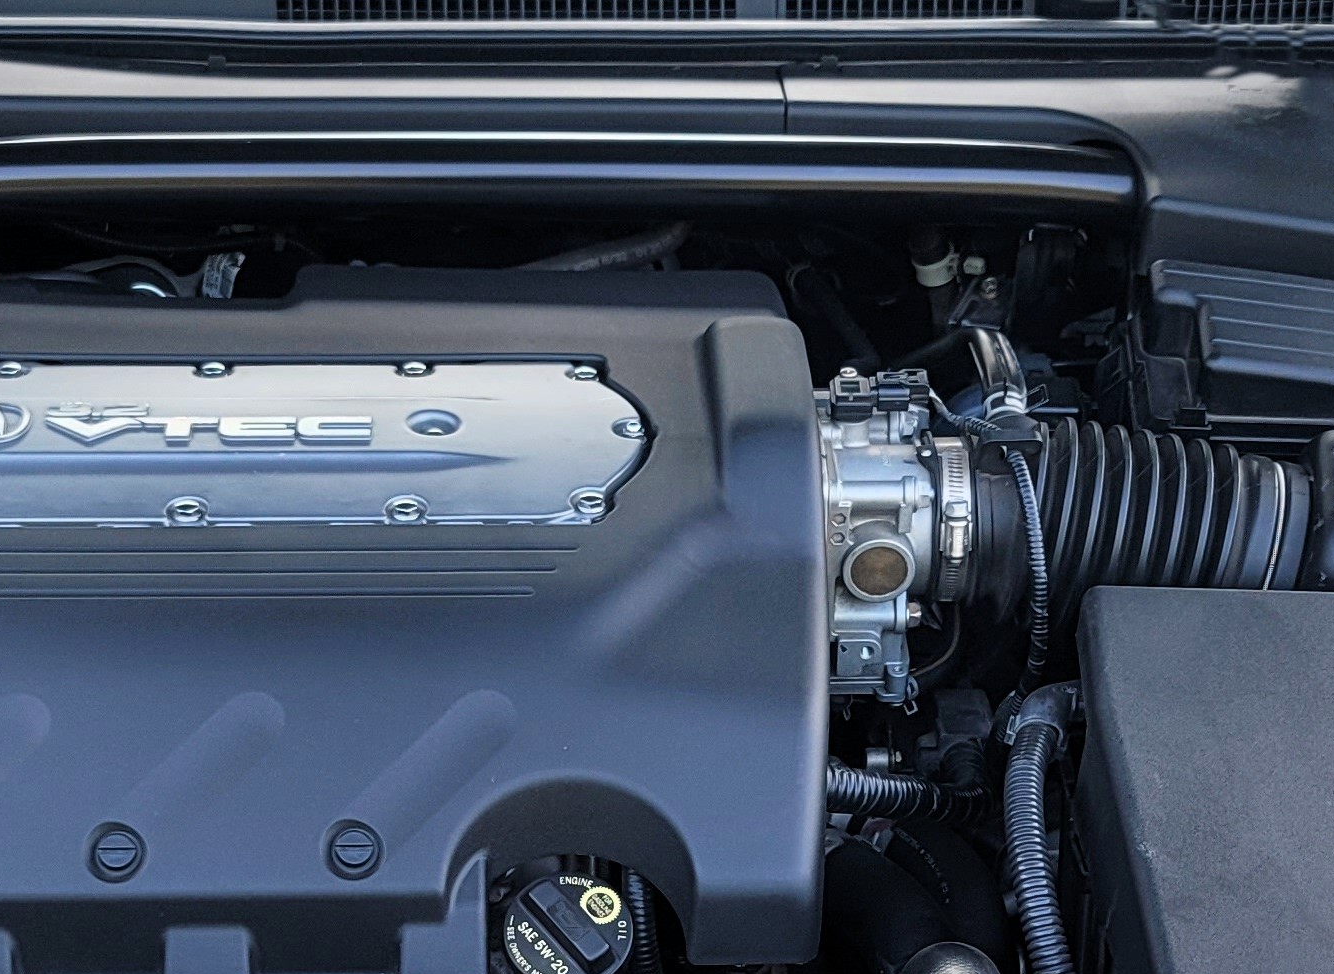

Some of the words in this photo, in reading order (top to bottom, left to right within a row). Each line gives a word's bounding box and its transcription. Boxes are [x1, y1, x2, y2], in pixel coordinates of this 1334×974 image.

[45, 415, 373, 447] VTEC
[559, 876, 594, 889] ENGINE
[617, 920, 628, 941] OIL
[507, 926, 515, 941] SEE
[517, 921, 539, 943] SAE
[509, 942, 532, 971] OWNER'S
